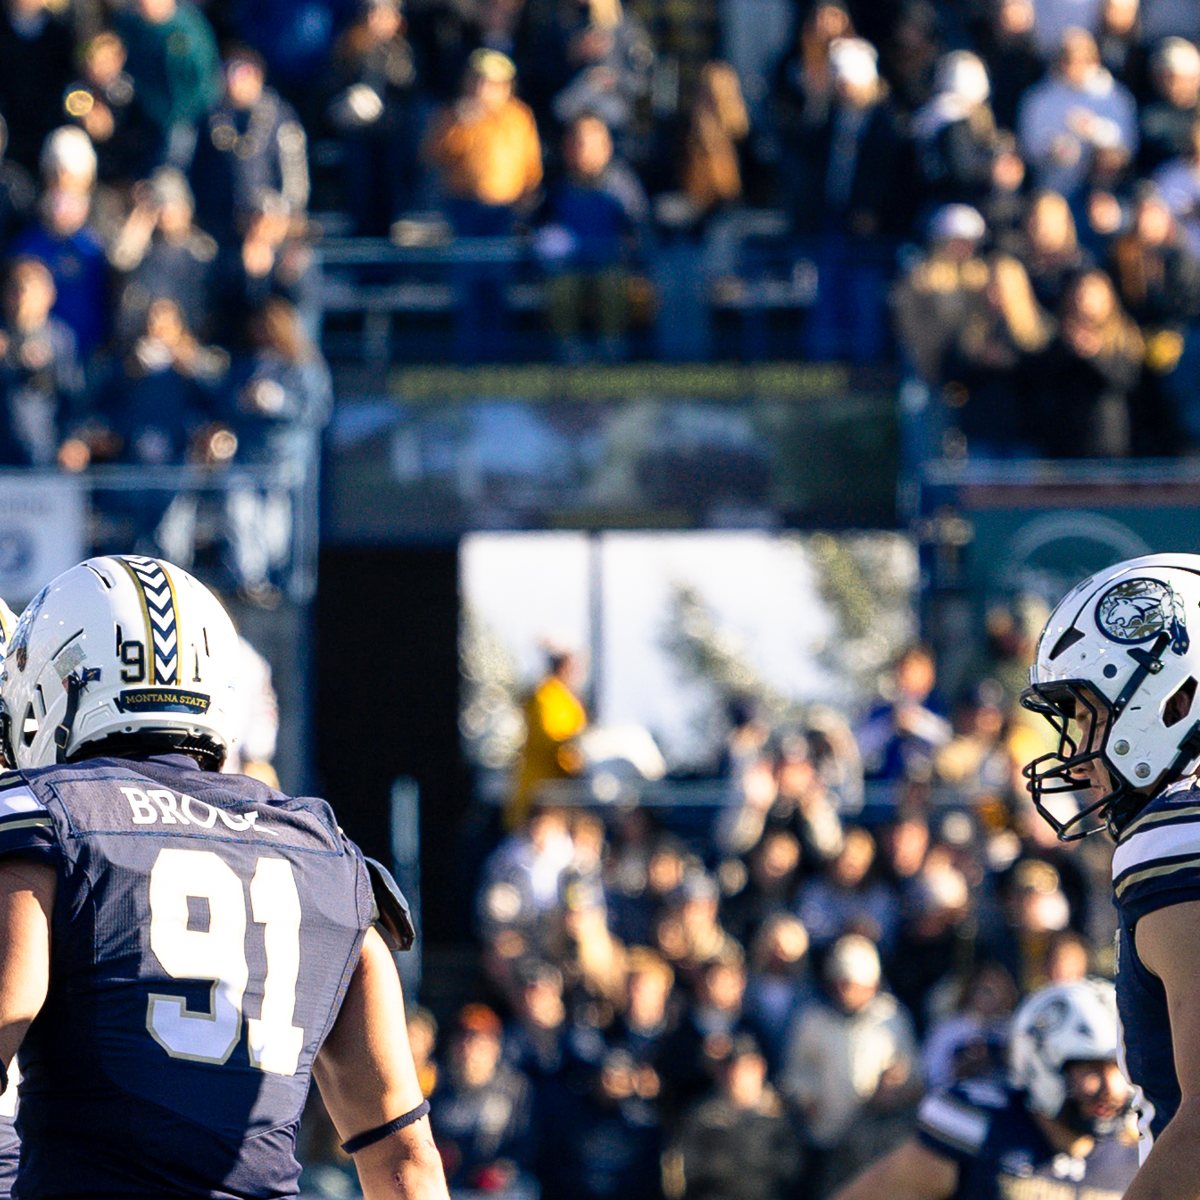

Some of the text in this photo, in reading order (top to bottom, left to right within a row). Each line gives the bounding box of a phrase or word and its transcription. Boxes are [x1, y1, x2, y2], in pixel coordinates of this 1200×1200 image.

[120, 640, 145, 683] 9
[126, 694, 207, 709] MONTANA STATE
[146, 848, 305, 1077] 91
